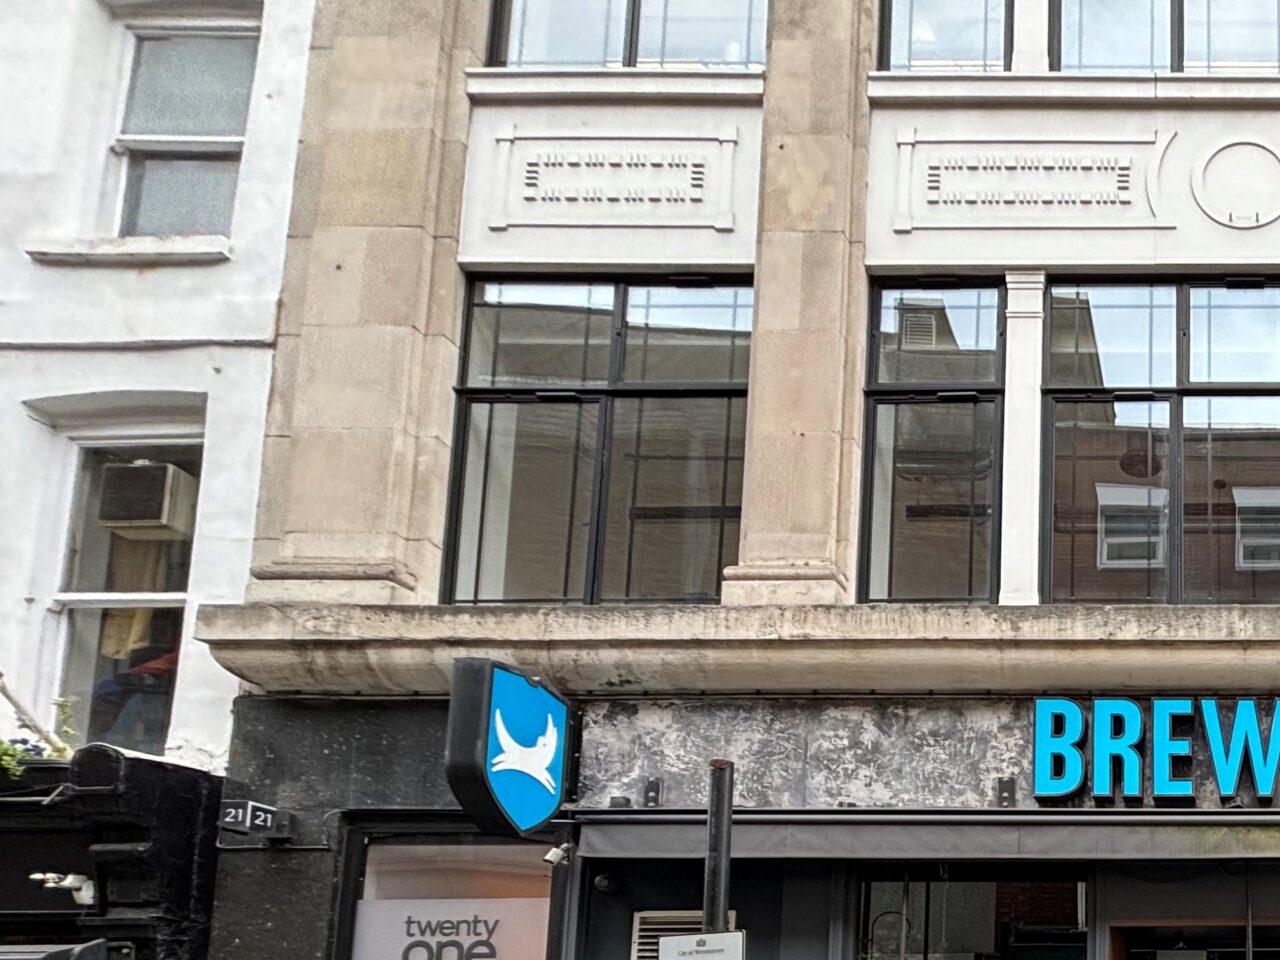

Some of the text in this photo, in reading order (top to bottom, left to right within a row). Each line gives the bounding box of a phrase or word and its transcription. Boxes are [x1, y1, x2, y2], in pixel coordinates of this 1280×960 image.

[224, 808, 244, 822] 21
[254, 811, 272, 827] 21
[405, 915, 500, 941] twenty
